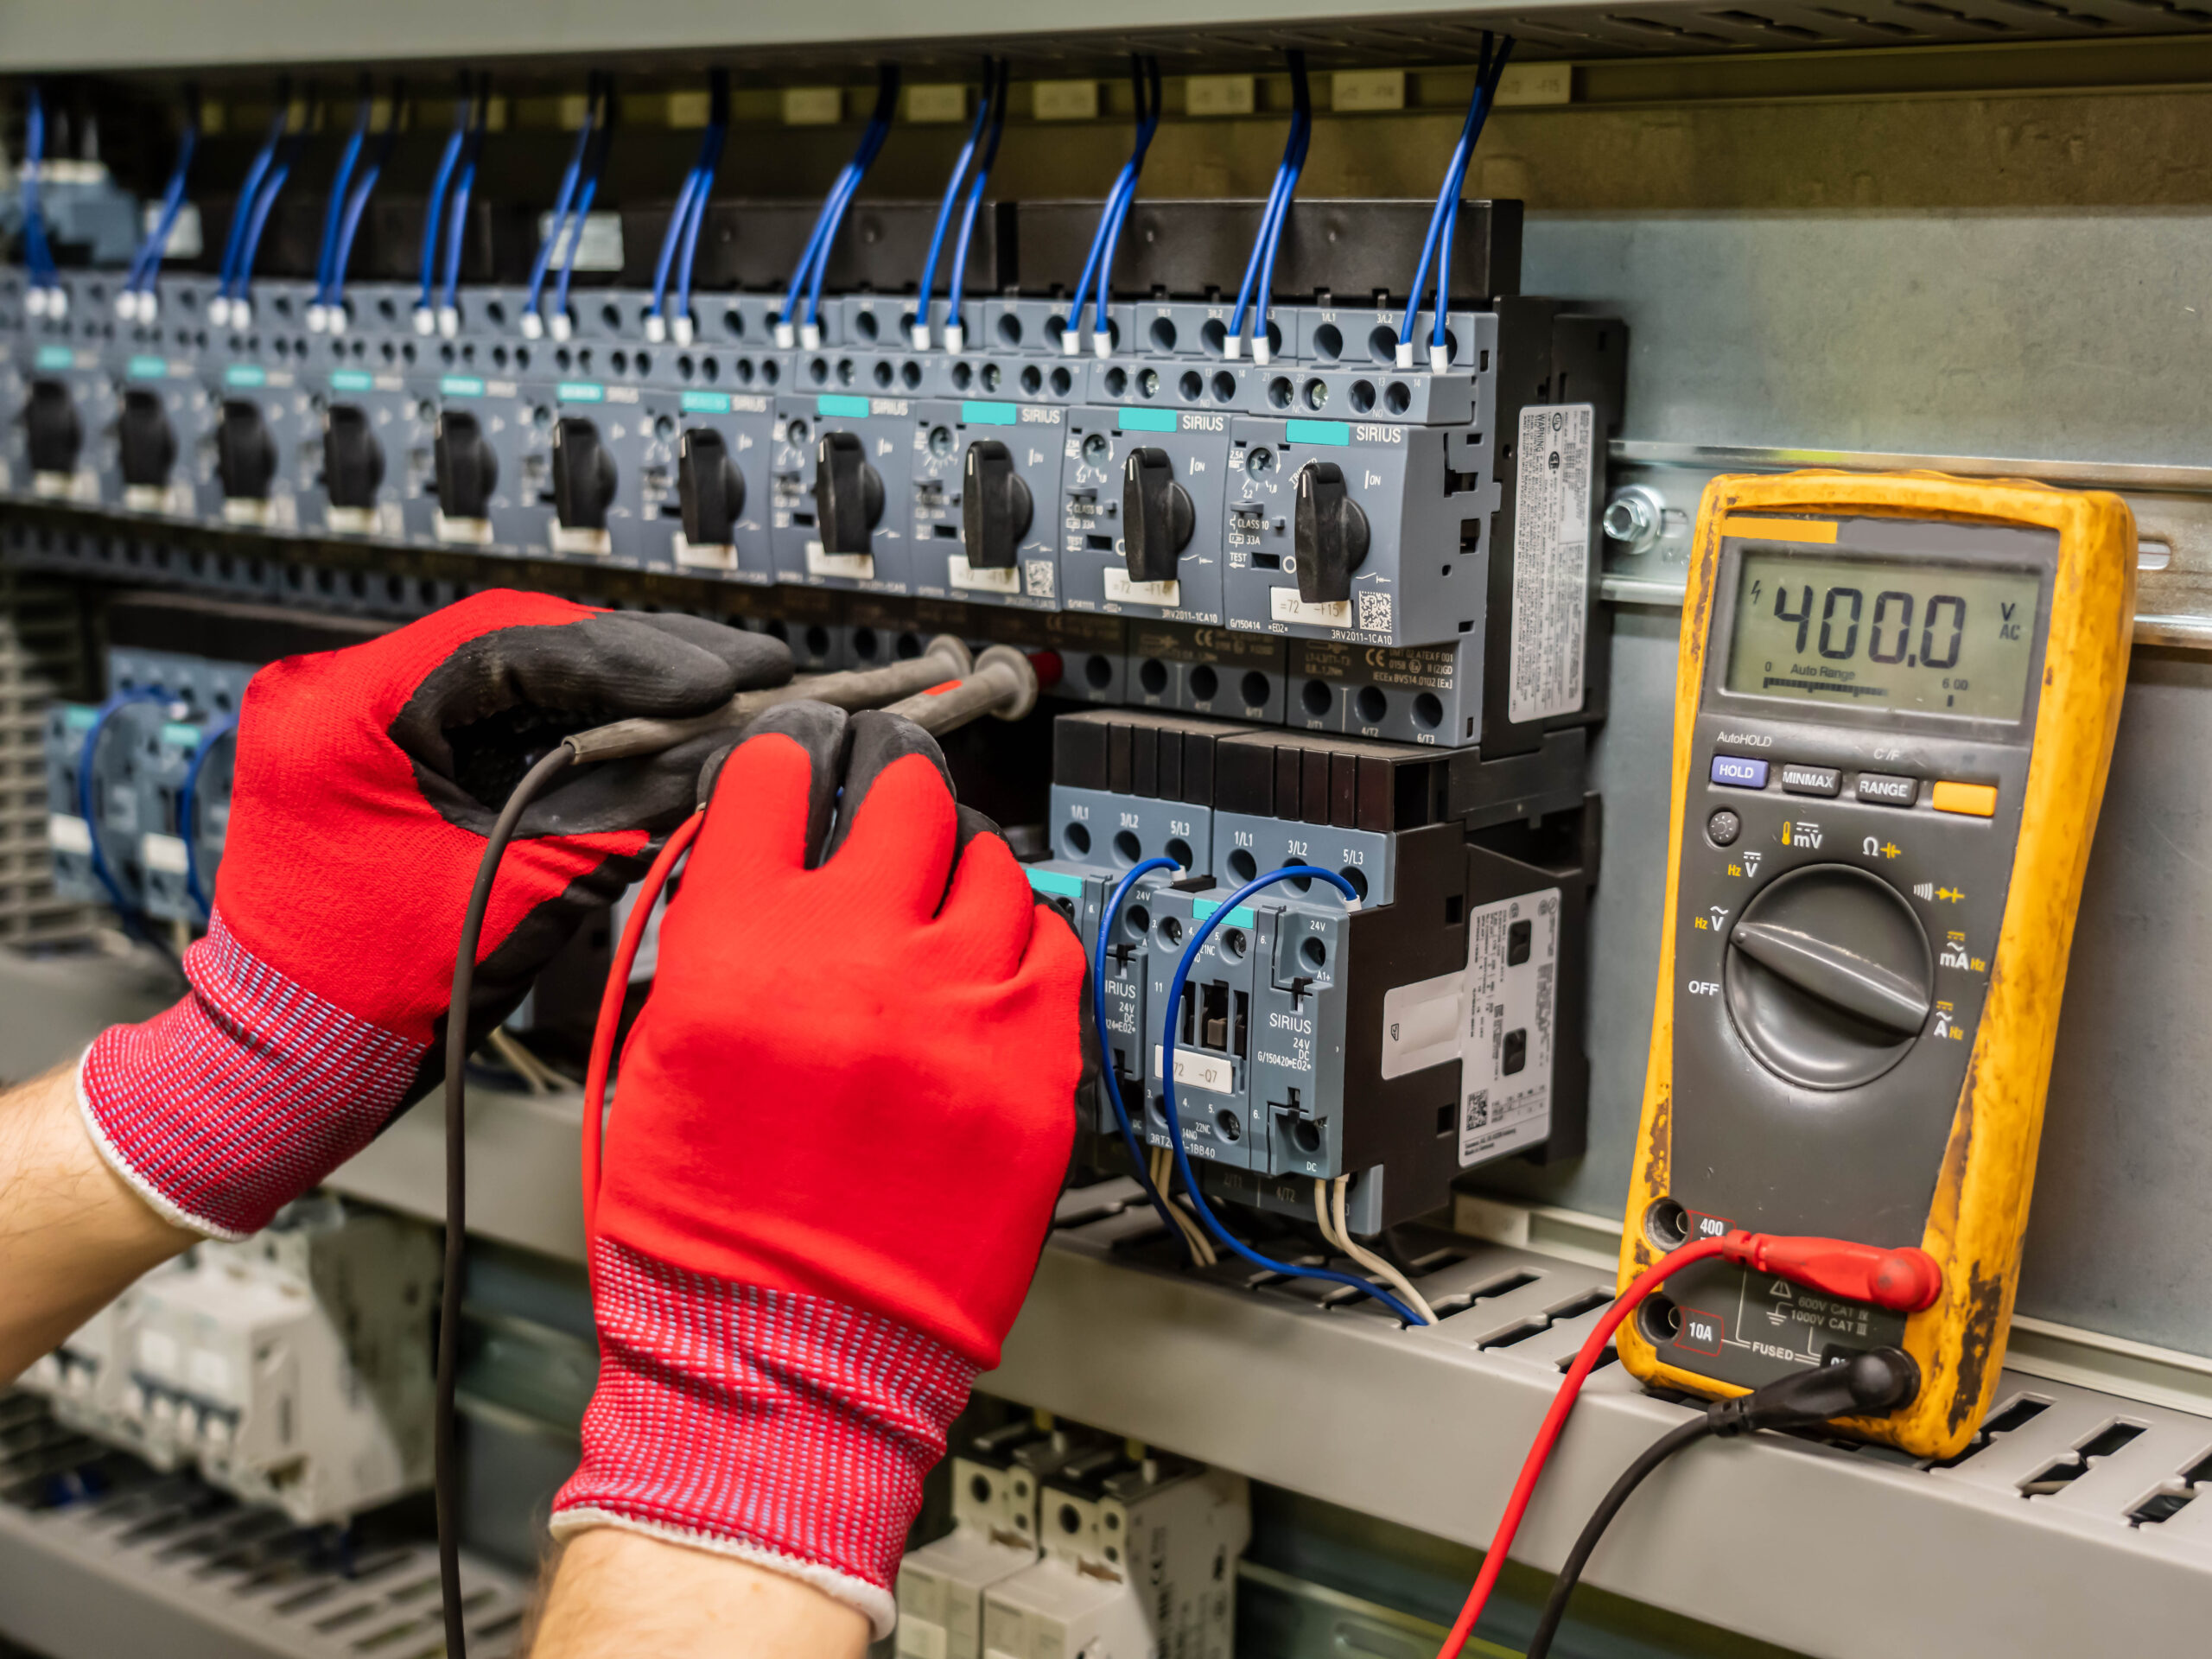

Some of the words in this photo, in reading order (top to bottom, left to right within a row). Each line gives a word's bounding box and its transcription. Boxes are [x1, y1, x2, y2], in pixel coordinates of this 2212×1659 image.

[1322, 313, 1336, 322] 1/L1
[1376, 314, 1393, 324] 3/L2
[1262, 373, 1270, 382] 21
[1297, 374, 1305, 383] 22
[1378, 378, 1386, 386] 13
[1414, 378, 1421, 388] 14
[1022, 408, 1060, 424] SIRIUS
[1292, 405, 1303, 414] NC
[1182, 415, 1224, 431] SIRIUS
[1356, 426, 1402, 443] SIRIUS
[1195, 461, 1205, 472] ON
[1370, 476, 1381, 486] ON
[1238, 519, 1260, 529] CLASS
[1262, 520, 1269, 531] 10
[1247, 536, 1261, 545] 33A
[1230, 552, 1247, 562] TEST
[2001, 602, 2015, 621] V
[1774, 585, 1966, 669] 400.0
[1999, 624, 2020, 640] AC
[1331, 629, 1392, 645] 3RV2011-1CA10
[1365, 648, 1385, 667] CE
[1764, 662, 1771, 672] 0
[1790, 664, 1817, 677] Auto
[1820, 667, 1855, 681] Range
[1362, 727, 1379, 737] 4/T2
[1417, 734, 1434, 744] 6/T3
[1717, 731, 1772, 747] AutoHOLD
[1719, 764, 1754, 779] HOLD
[1783, 771, 1834, 788] MINMAX
[1859, 780, 1908, 798] RANGE
[1071, 805, 1089, 820] 1/L1
[1121, 813, 1139, 829] 3/L2
[1171, 821, 1190, 836] 5/L3
[1235, 830, 1253, 847] 1/L1
[1794, 833, 1822, 849] mV
[1287, 840, 1307, 856] 3/L2
[1343, 849, 1363, 865] 5/L3
[1728, 865, 1741, 877] Hz
[1745, 862, 1758, 878] V
[1136, 891, 1150, 900] 24V
[1152, 920, 1158, 929] 3.
[1310, 920, 1325, 931] 24V
[1694, 917, 1708, 931] Hz
[1189, 927, 1195, 936] 4.
[1215, 932, 1220, 941] 5.
[1260, 936, 1267, 944] 6.
[1940, 951, 1969, 971] mA
[1970, 957, 1986, 972] Hz
[1317, 970, 1331, 981] A1+
[1104, 979, 1136, 999] IRIUS
[1155, 982, 1163, 993] 11
[1688, 981, 1719, 996] OFF
[1119, 1001, 1135, 1013] 24V
[1124, 1013, 1135, 1024] DC
[1269, 1013, 1312, 1034] SIRIUS
[1934, 1020, 1948, 1038] A
[1948, 1027, 1963, 1041] Hz
[1294, 1038, 1310, 1049] 24V
[1299, 1049, 1310, 1061] DC
[1174, 1062, 1184, 1077] 72
[1147, 1090, 1153, 1098] 3.
[1183, 1098, 1189, 1108] 4.
[1209, 1104, 1215, 1113] 5.
[1254, 1110, 1260, 1119] 6.
[1182, 1128, 1197, 1140] 14NO
[1196, 1122, 1211, 1134] 22NC
[1150, 1133, 1215, 1158] 3RT2-1BB40
[1306, 1161, 1317, 1172] DC
[1276, 1186, 1295, 1202] 4/T2
[1700, 1217, 1724, 1236] 400
[1798, 1297, 1827, 1311] 600V
[1831, 1303, 1854, 1318] CAT
[1791, 1309, 1826, 1326] 1000V
[1829, 1317, 1854, 1332] CAT
[1689, 1321, 1713, 1342] 10A
[1752, 1341, 1795, 1361] FUSED
